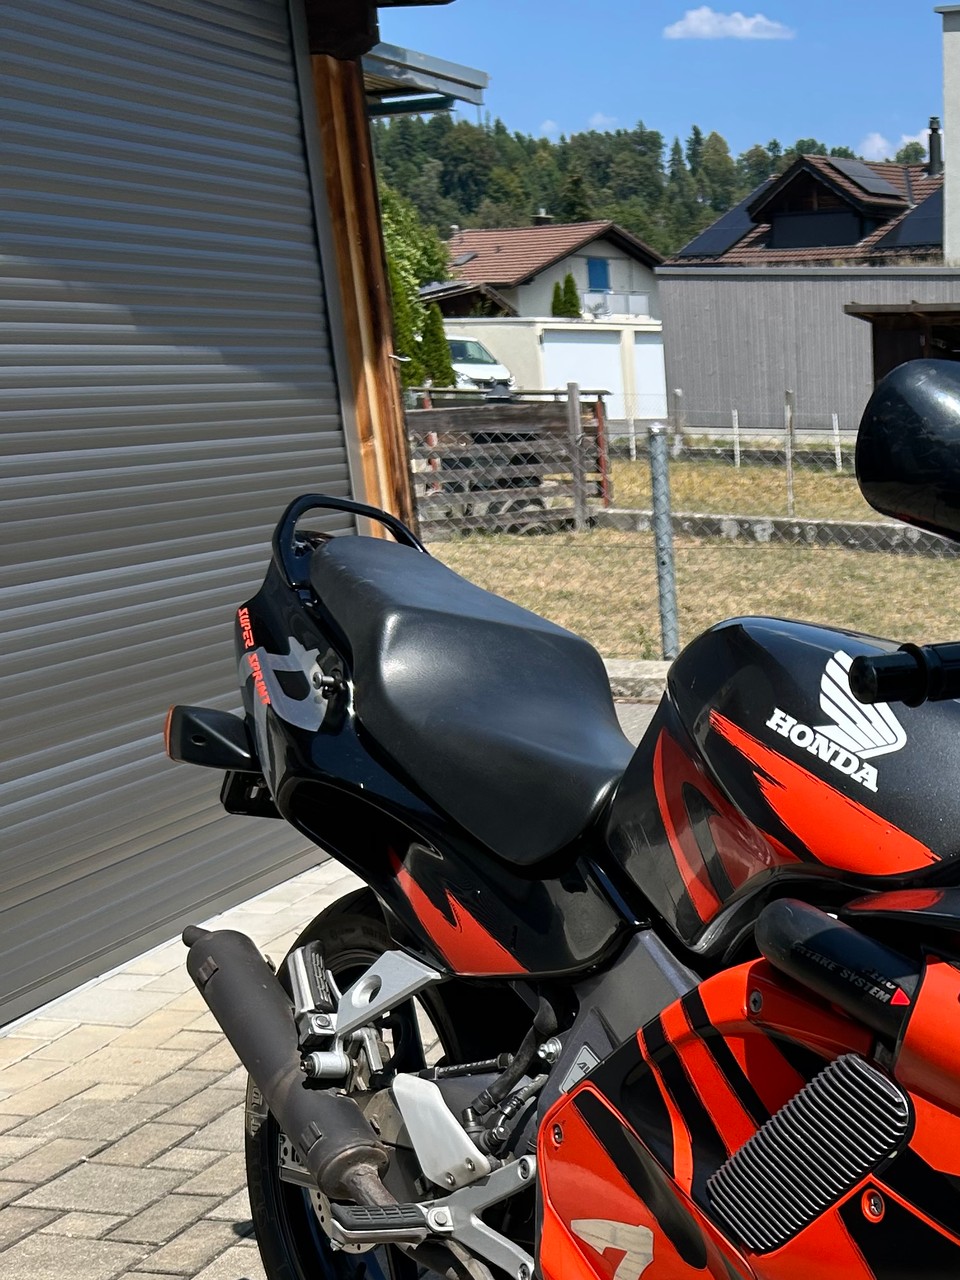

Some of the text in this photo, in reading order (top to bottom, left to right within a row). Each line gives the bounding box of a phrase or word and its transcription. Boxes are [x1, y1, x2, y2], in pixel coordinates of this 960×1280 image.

[238, 607, 271, 705] SUPER SPRINT
[765, 706, 879, 793] HONDA
[839, 969, 891, 1003] SYSTEM
